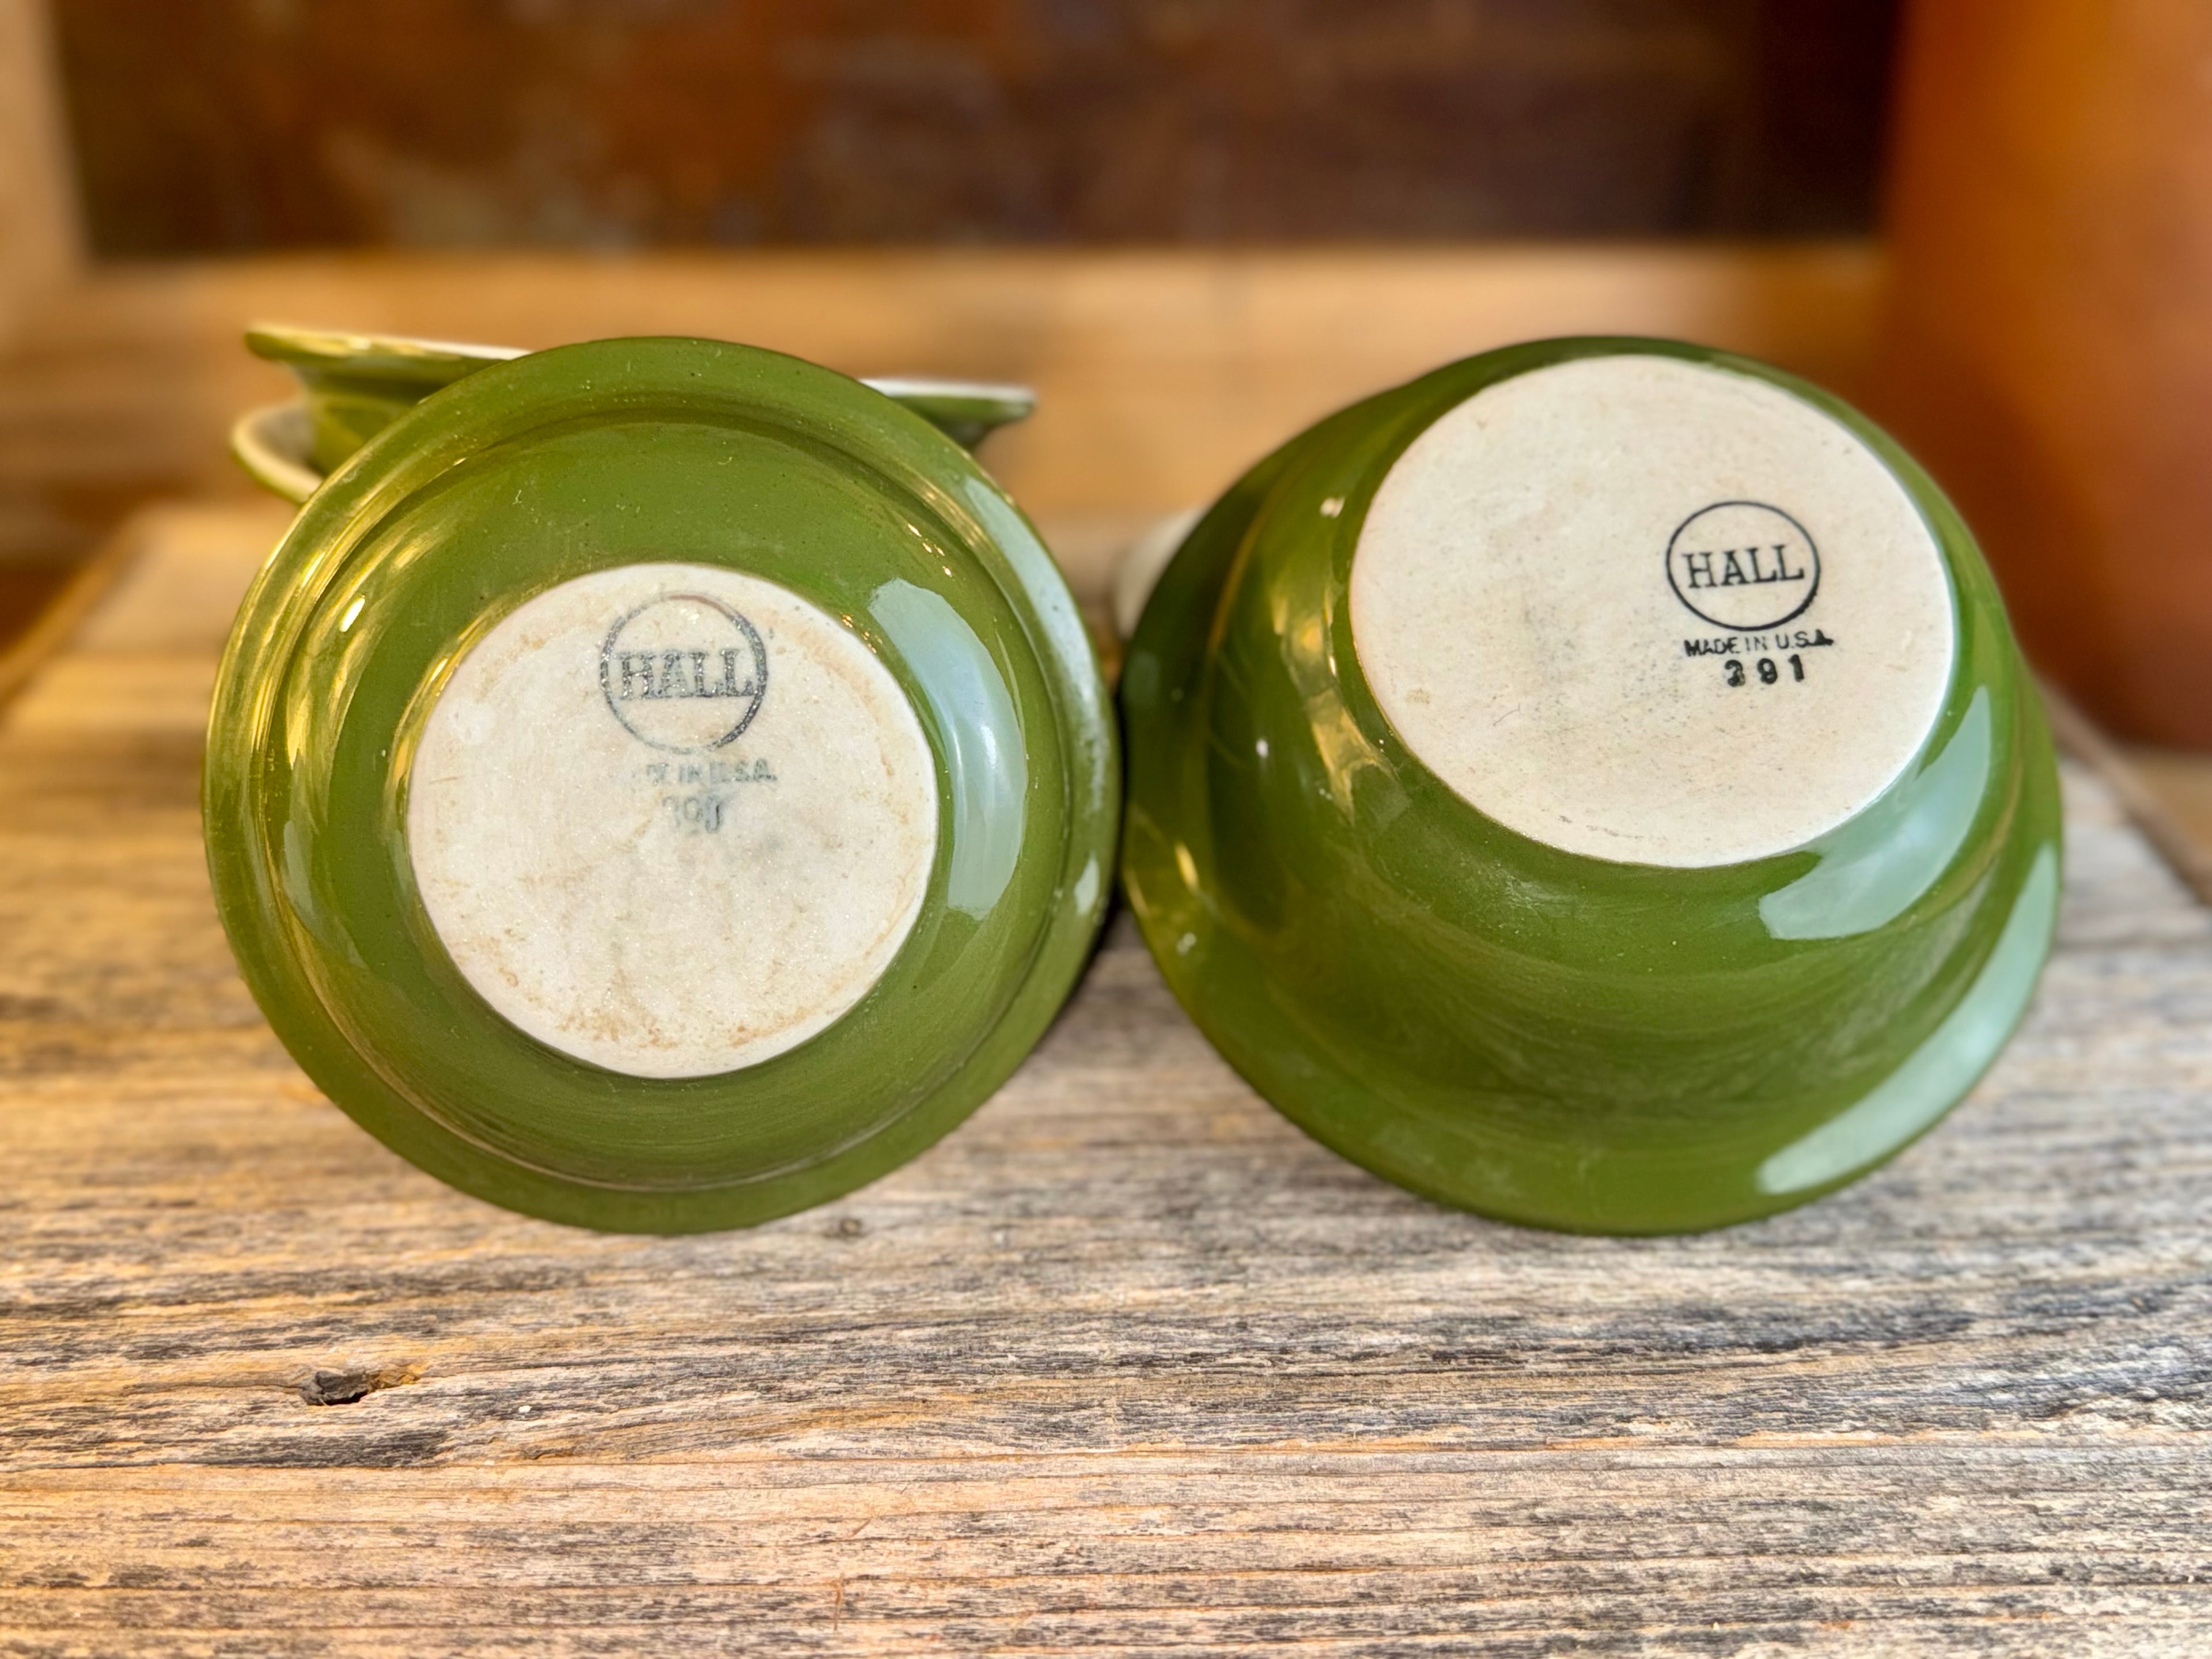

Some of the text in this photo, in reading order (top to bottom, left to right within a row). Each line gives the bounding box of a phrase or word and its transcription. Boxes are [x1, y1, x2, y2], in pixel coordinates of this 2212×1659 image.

[1682, 544, 1805, 589] HALL
[1684, 636, 1740, 657] MADE
[1745, 635, 1768, 652] IN
[616, 648, 758, 700] HALL
[1724, 653, 1805, 687] 391
